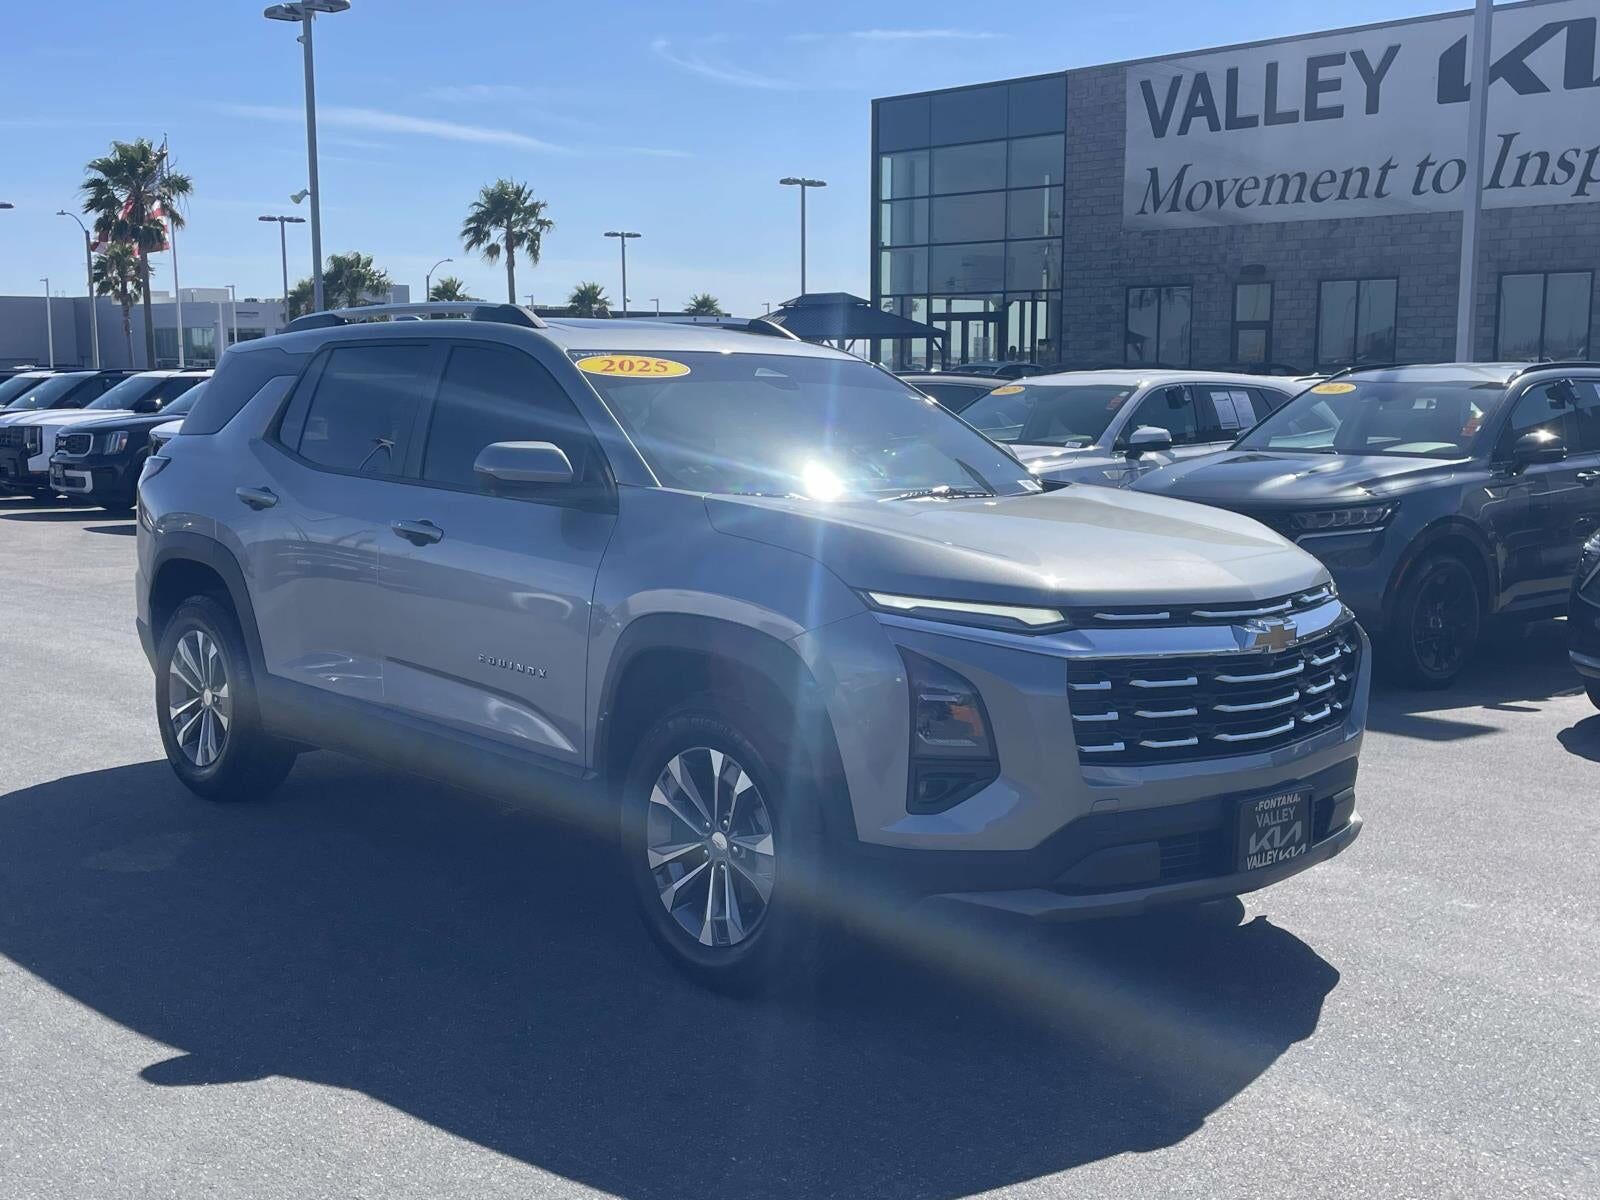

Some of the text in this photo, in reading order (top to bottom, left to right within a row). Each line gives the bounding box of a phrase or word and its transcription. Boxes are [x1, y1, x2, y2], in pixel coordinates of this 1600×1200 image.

[1140, 43, 1402, 139] VALLEY
[1135, 155, 1399, 216] Movement
[1412, 153, 1467, 196] to
[600, 359, 669, 373] 2025
[478, 653, 548, 678] EQUINOX
[1256, 806, 1296, 828] VALLEY
[1246, 849, 1278, 871] VALLEY
